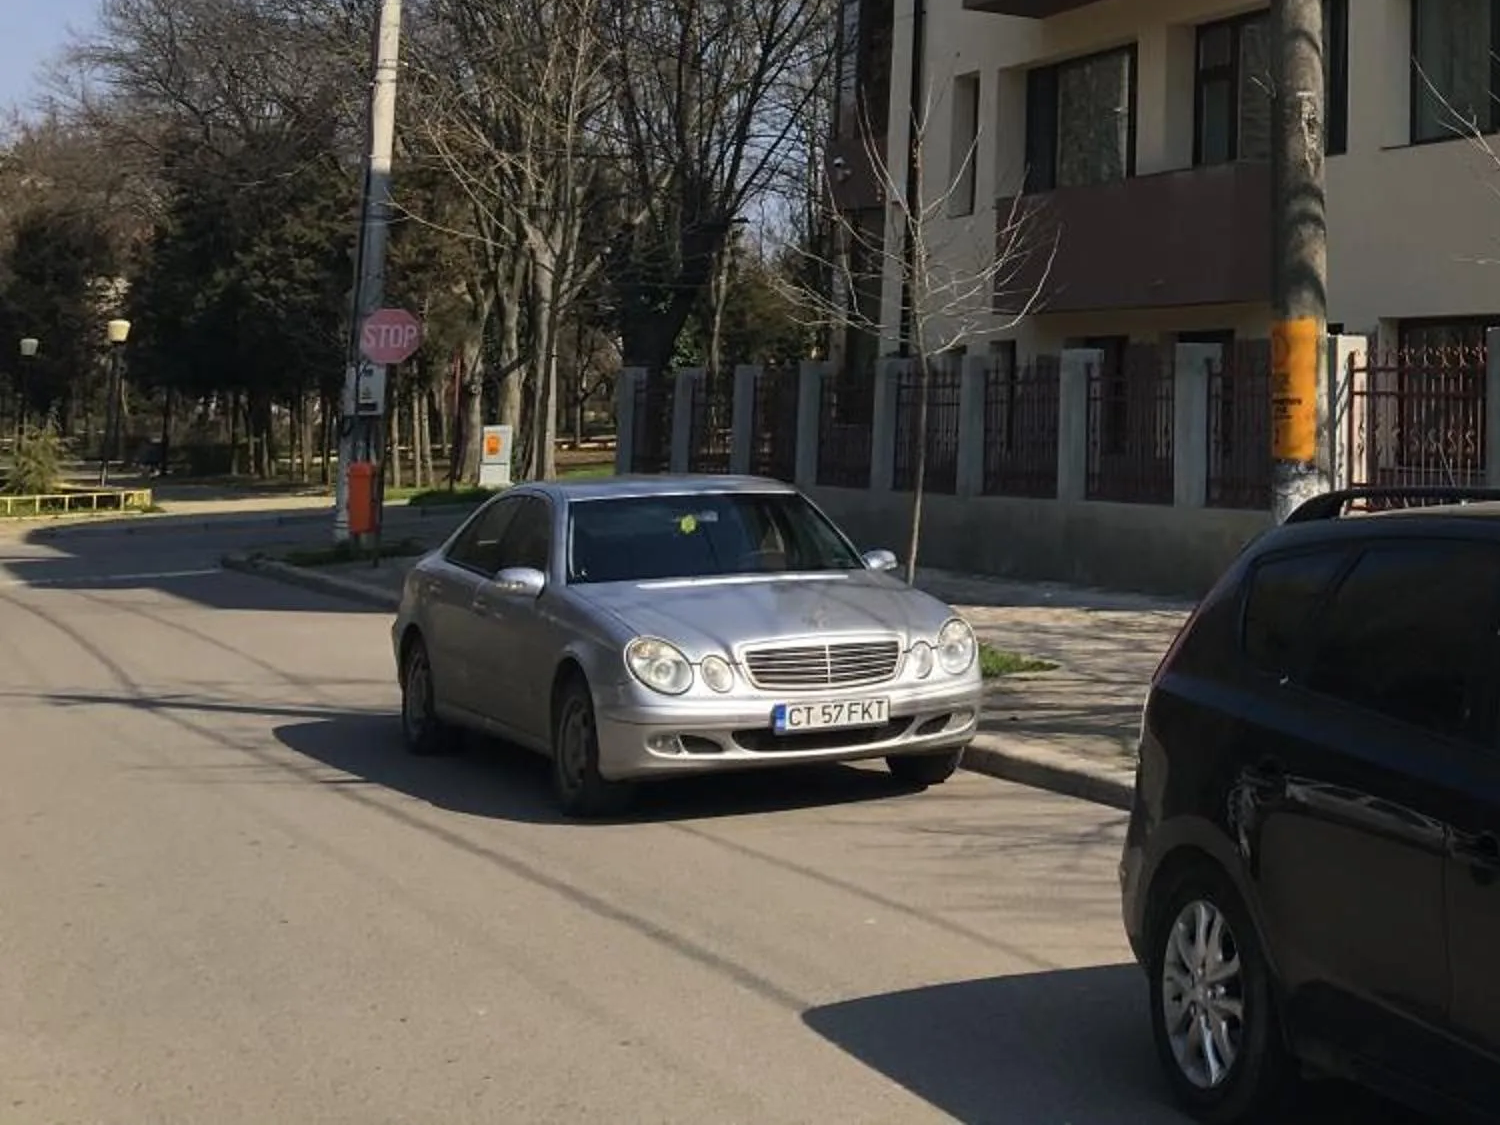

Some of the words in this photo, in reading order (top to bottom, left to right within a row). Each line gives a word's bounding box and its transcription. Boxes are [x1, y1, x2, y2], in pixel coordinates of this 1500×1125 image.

[363, 325, 417, 348] STOP
[789, 706, 814, 725] CT
[821, 704, 844, 723] 57
[848, 700, 884, 720] FKT
